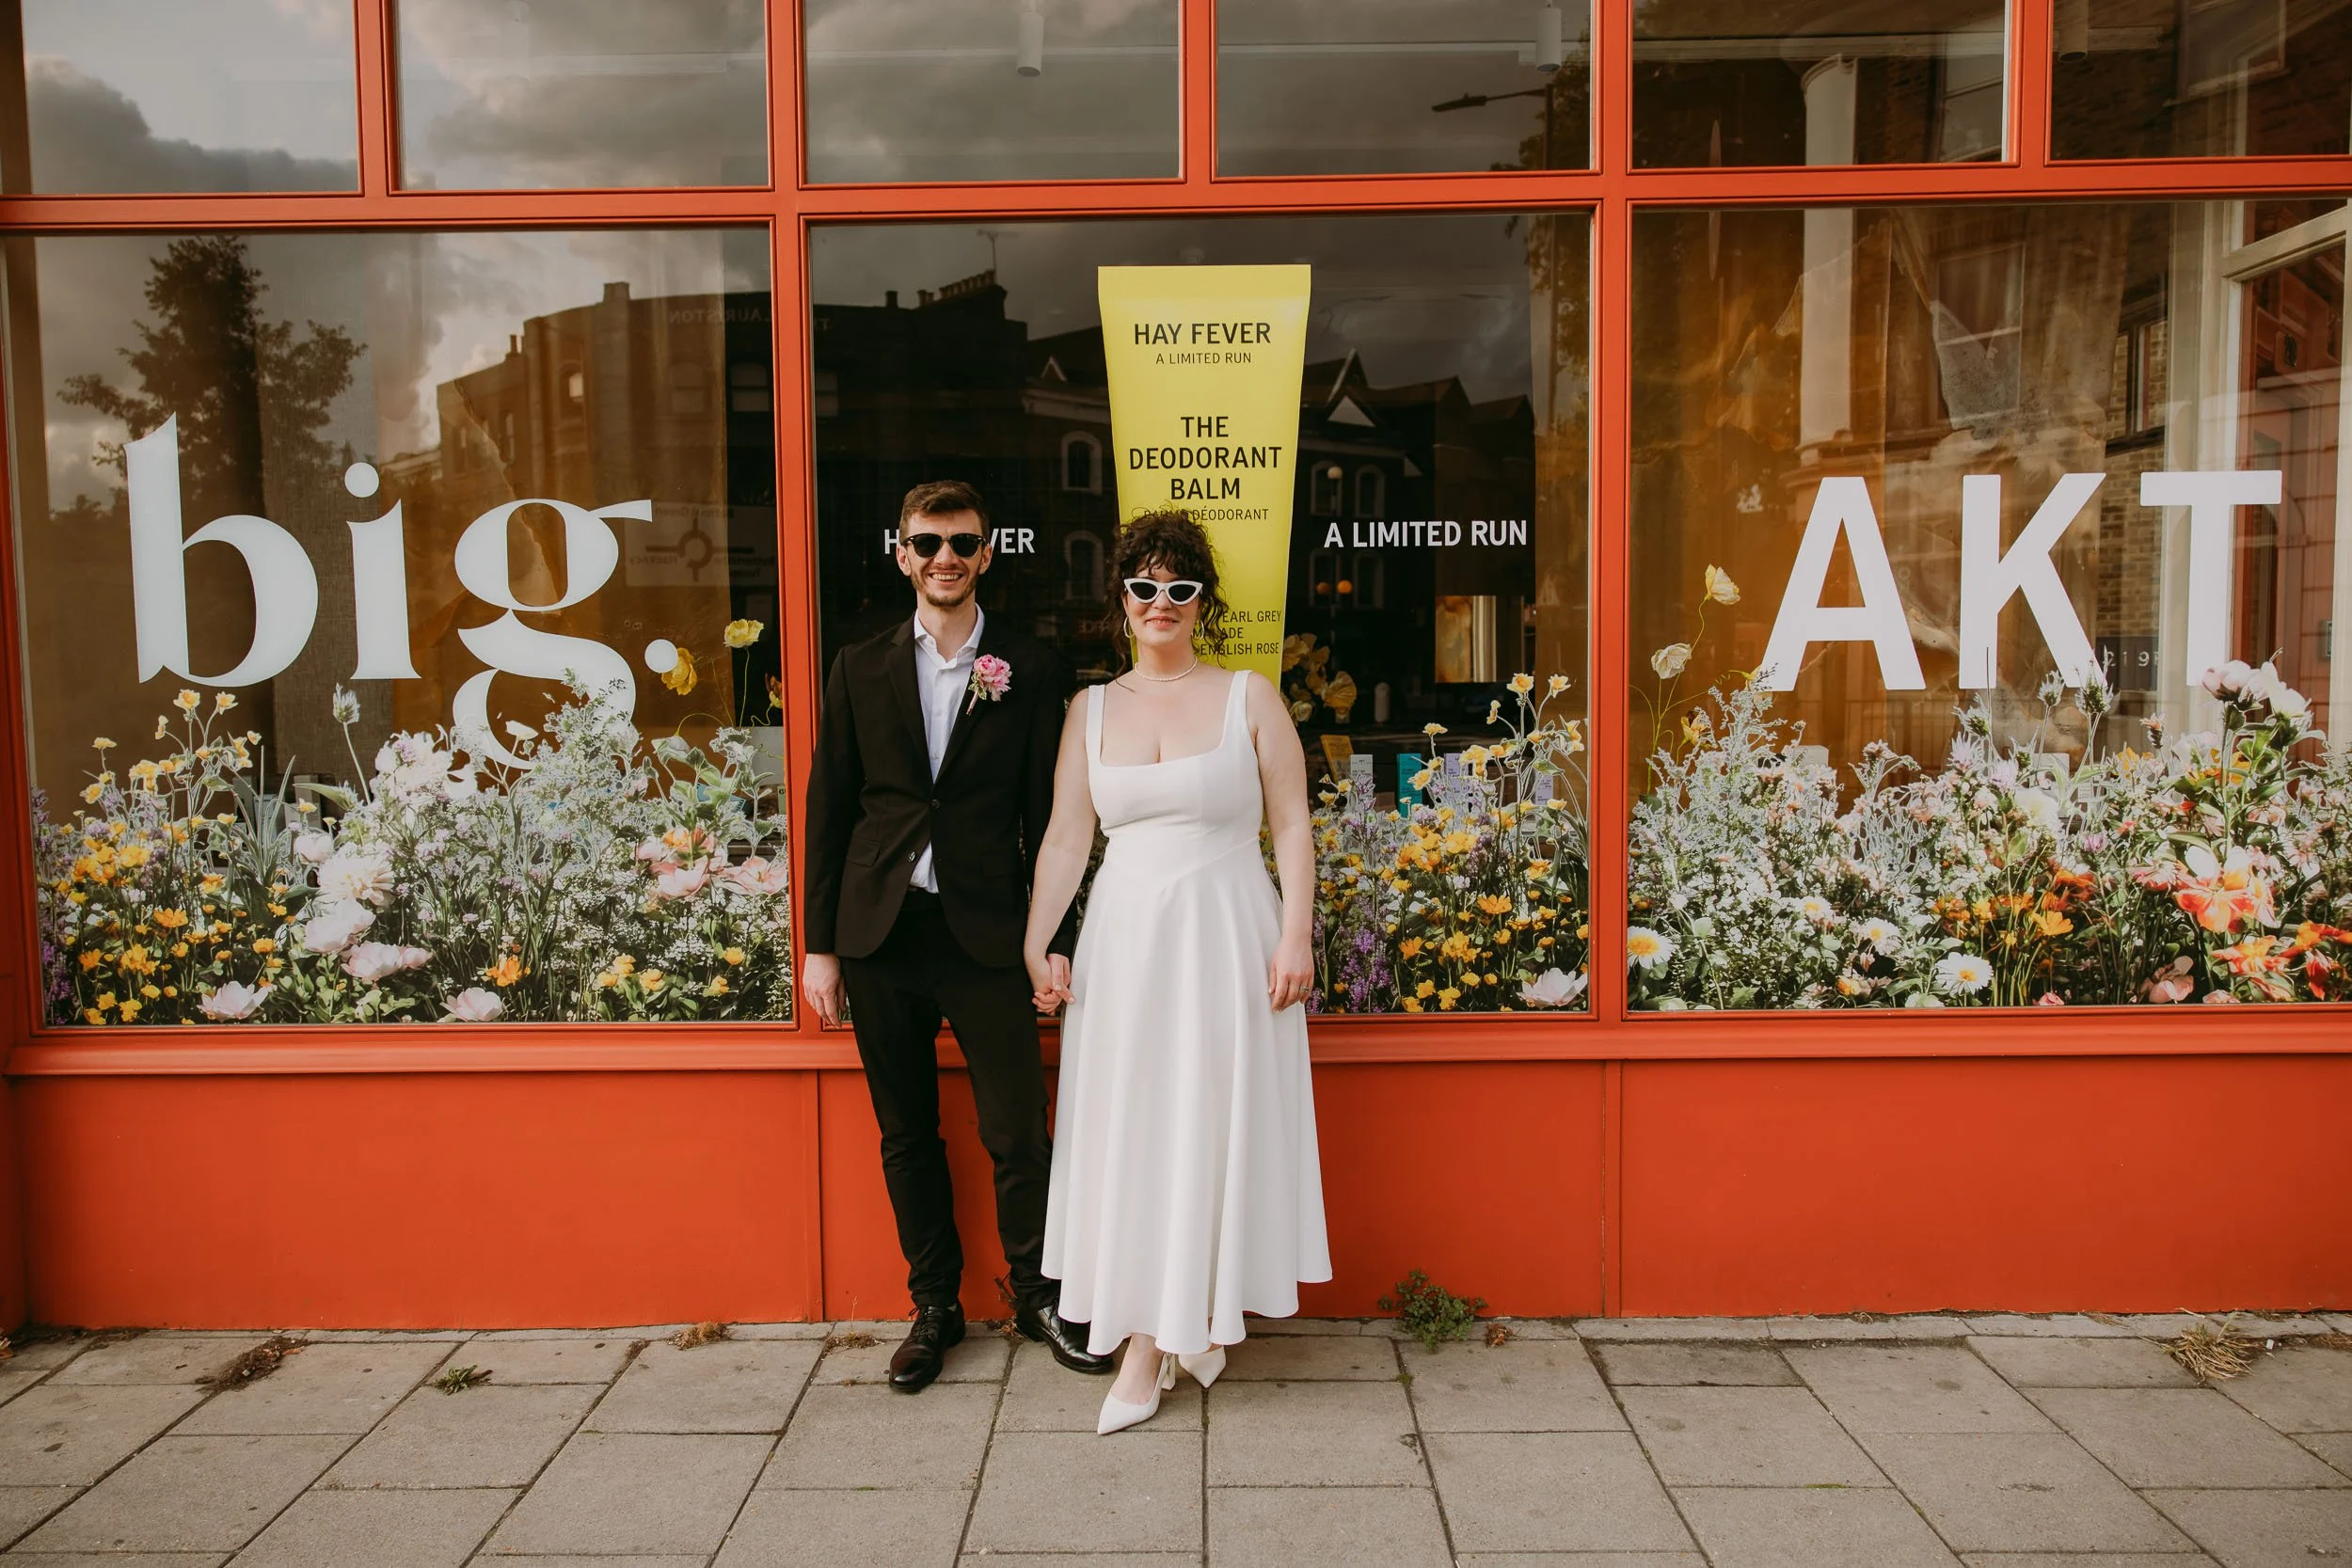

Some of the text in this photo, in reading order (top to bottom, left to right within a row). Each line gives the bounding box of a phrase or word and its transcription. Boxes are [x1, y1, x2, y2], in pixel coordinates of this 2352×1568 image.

[1134, 322, 1272, 345] HAY FEVER
[1155, 352, 1252, 365] A LIMITED RUN
[1181, 416, 1230, 438] THE
[1129, 446, 1282, 470] DEODORANT
[1170, 478, 1241, 500] BALM
[1192, 505, 1269, 521] DÉODORANT
[1324, 519, 1528, 549] A LIMITED RUN
[1761, 469, 2282, 691] AKT
[125, 413, 679, 770] big.
[1222, 610, 1281, 623] EARL GREY
[1200, 642, 1279, 656] ENGLISH ROSE
